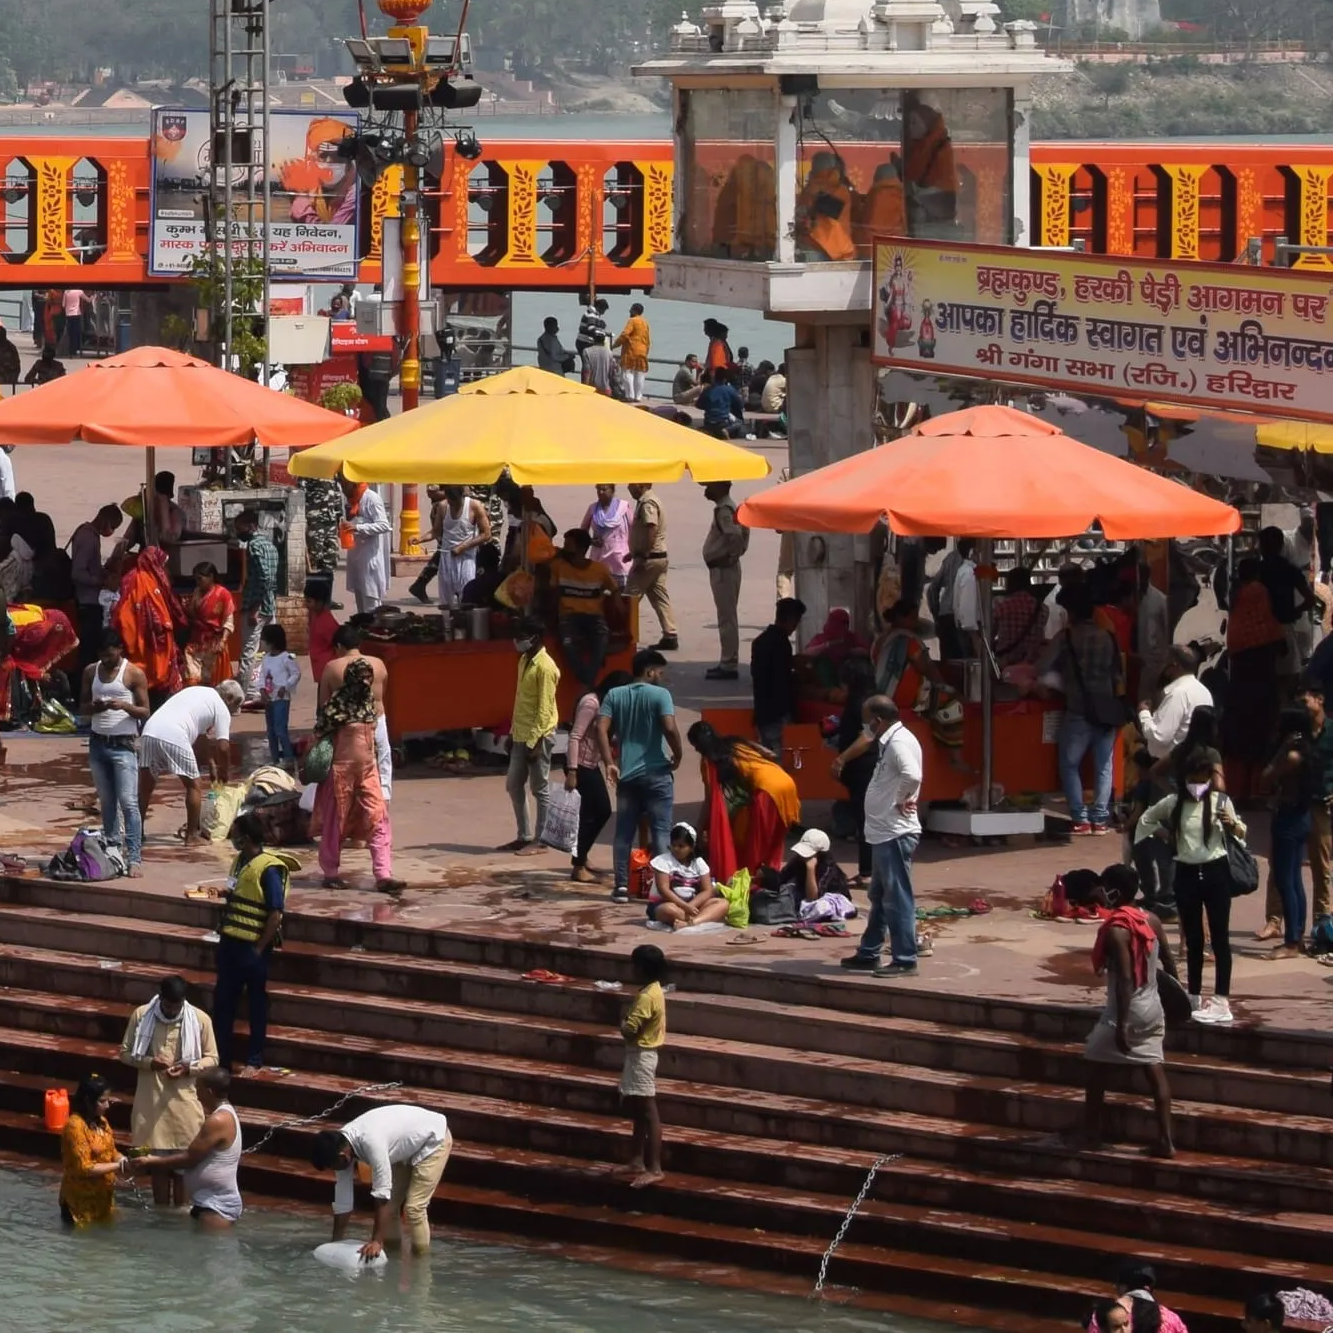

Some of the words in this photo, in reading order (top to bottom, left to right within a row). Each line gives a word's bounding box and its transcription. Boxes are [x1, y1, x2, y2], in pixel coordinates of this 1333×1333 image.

[159, 239, 194, 250] मास्क
[290, 240, 349, 254] अभिवादन
[165, 224, 196, 238] कुम्भ
[272, 227, 292, 239] यह
[1073, 269, 1135, 306] हरकी
[1187, 284, 1286, 319] आगमन
[1292, 293, 1328, 324] पर
[934, 301, 1005, 338] आपका
[1009, 299, 1081, 345] हार्दिक
[1085, 317, 1165, 357] स्वागत
[1170, 314, 1209, 362] एवं
[975, 343, 1004, 366] श्री
[1008, 348, 1061, 373] गंगा
[1065, 357, 1116, 380] सभा
[1123, 361, 1197, 394] (रजि.)
[1205, 369, 1298, 401] हरिद्वार
